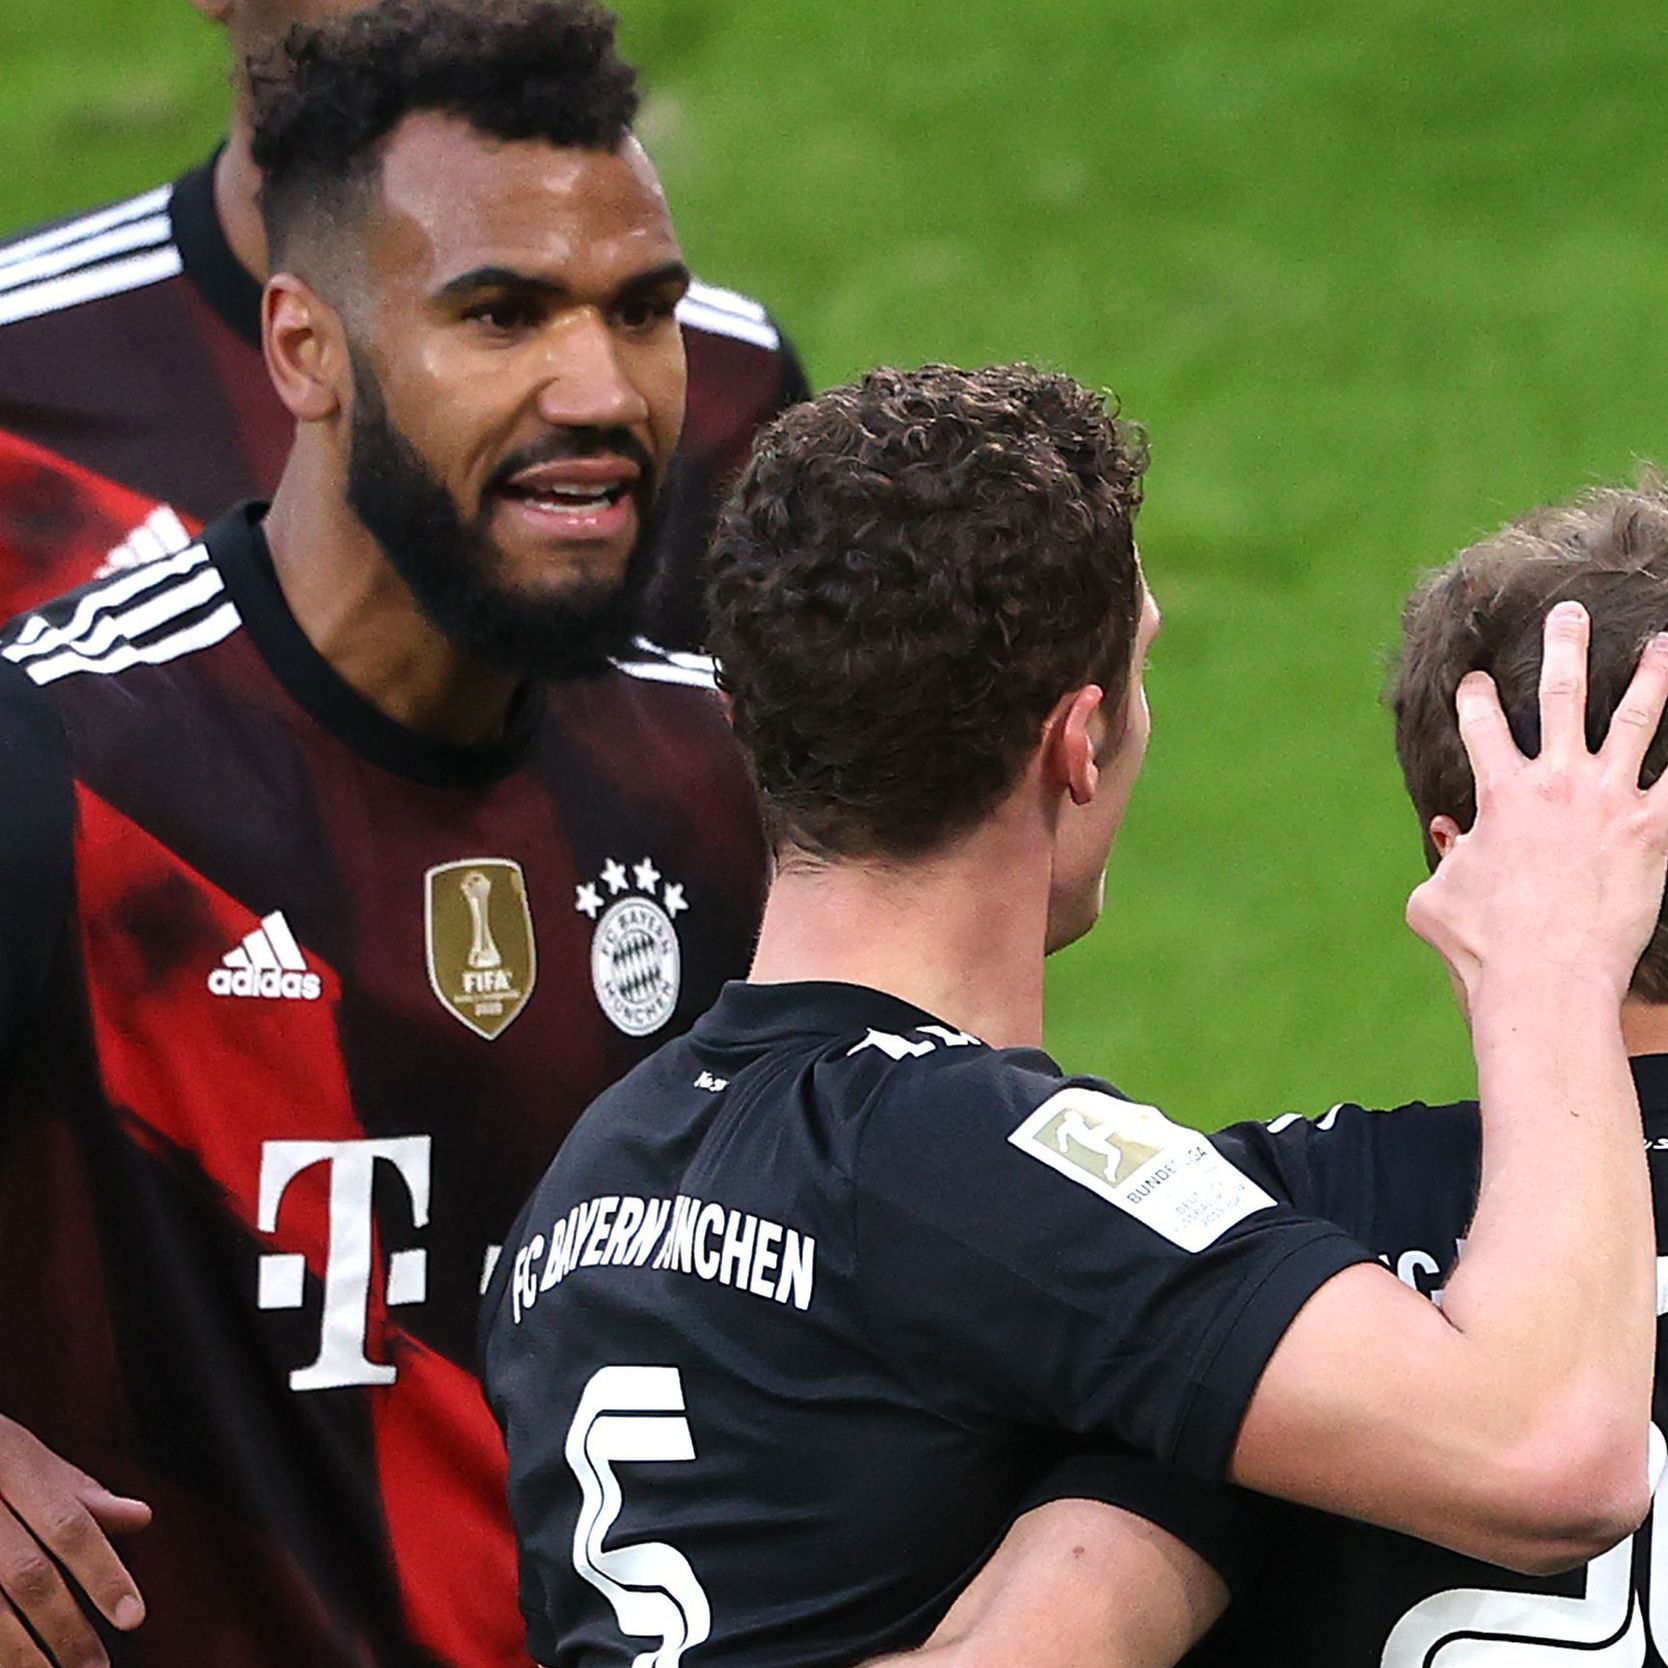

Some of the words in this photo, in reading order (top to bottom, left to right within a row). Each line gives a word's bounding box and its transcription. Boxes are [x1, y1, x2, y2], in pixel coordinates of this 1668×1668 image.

[208, 966, 321, 1000] adidas
[462, 969, 511, 993] FIFA
[257, 1136, 430, 1391] T
[512, 1234, 544, 1324] FC
[539, 1195, 672, 1292] BAYERN
